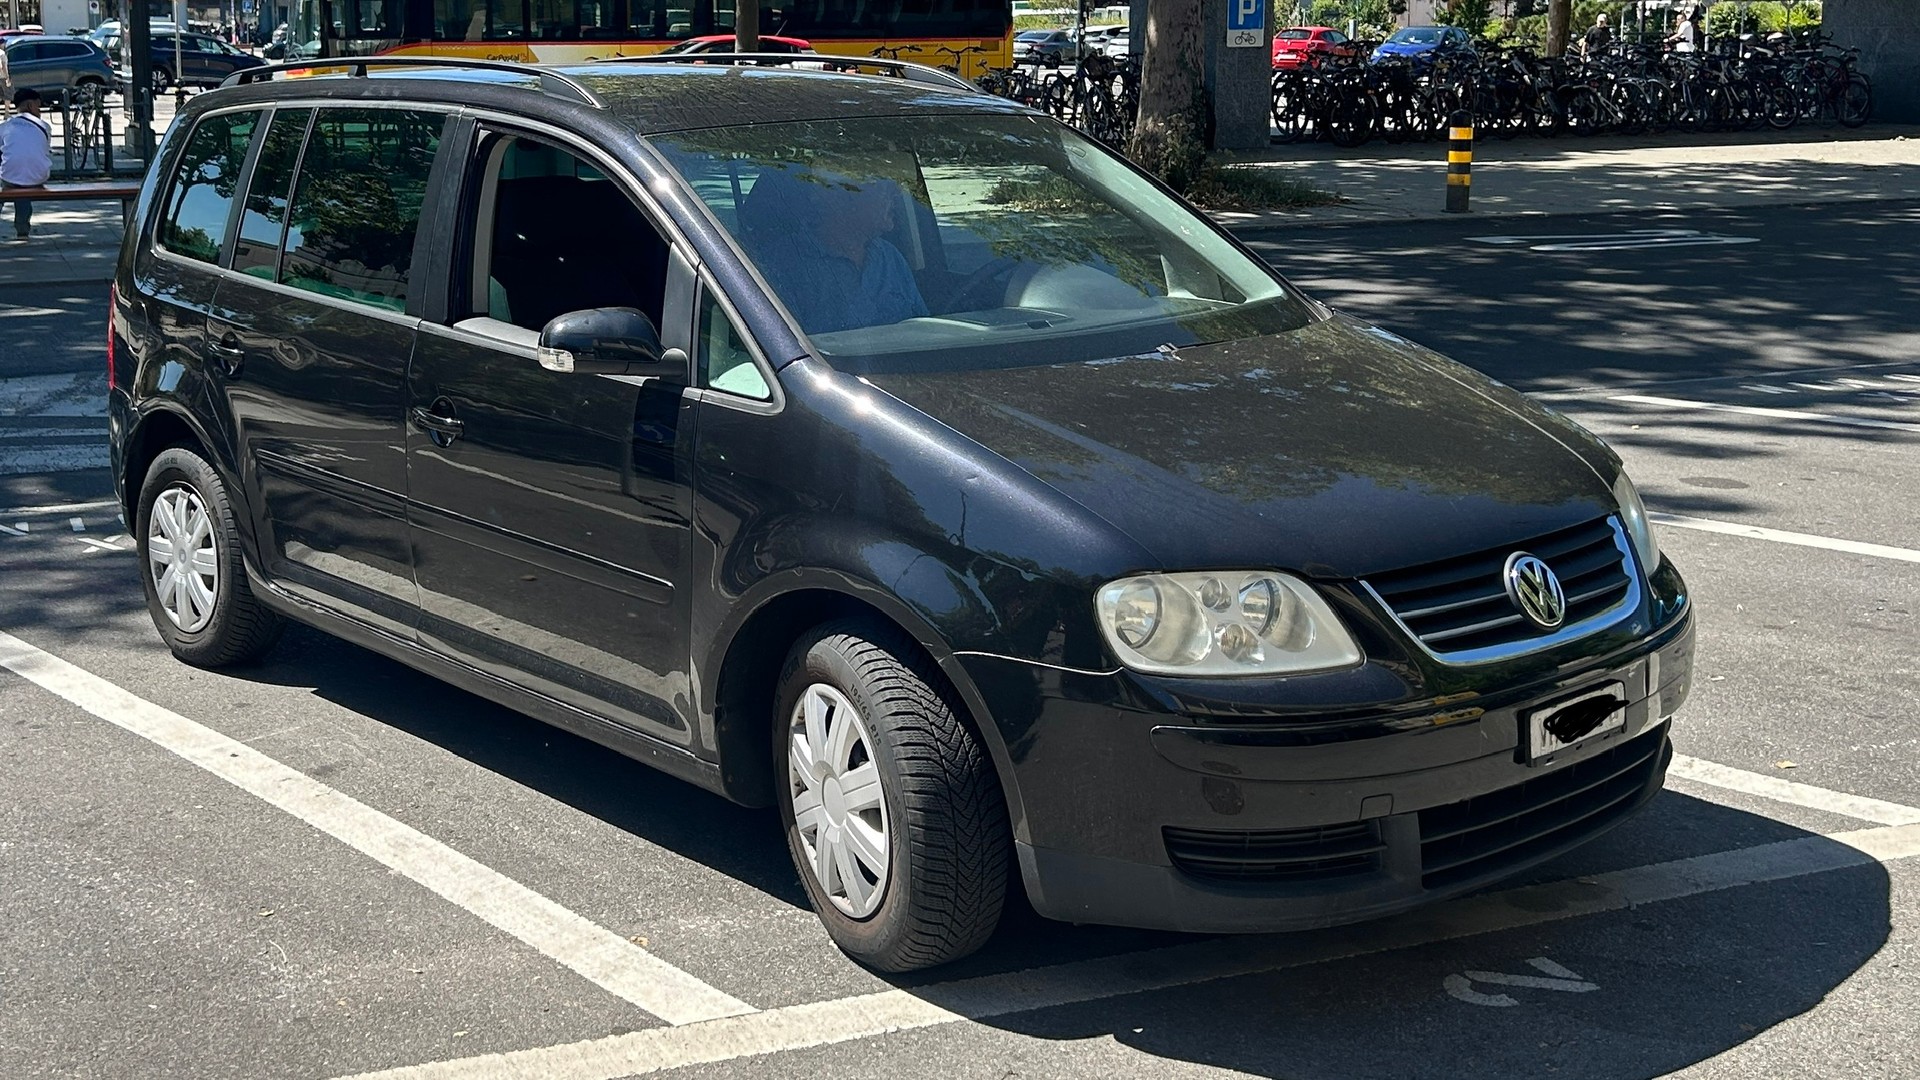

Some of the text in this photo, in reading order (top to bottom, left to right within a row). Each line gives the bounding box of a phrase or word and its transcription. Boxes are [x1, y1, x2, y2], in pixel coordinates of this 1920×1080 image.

[1238, 0, 1256, 25] P
[486, 53, 520, 63] CarPostal
[1514, 558, 1565, 626] VW
[850, 682, 882, 747] 195/65 R15
